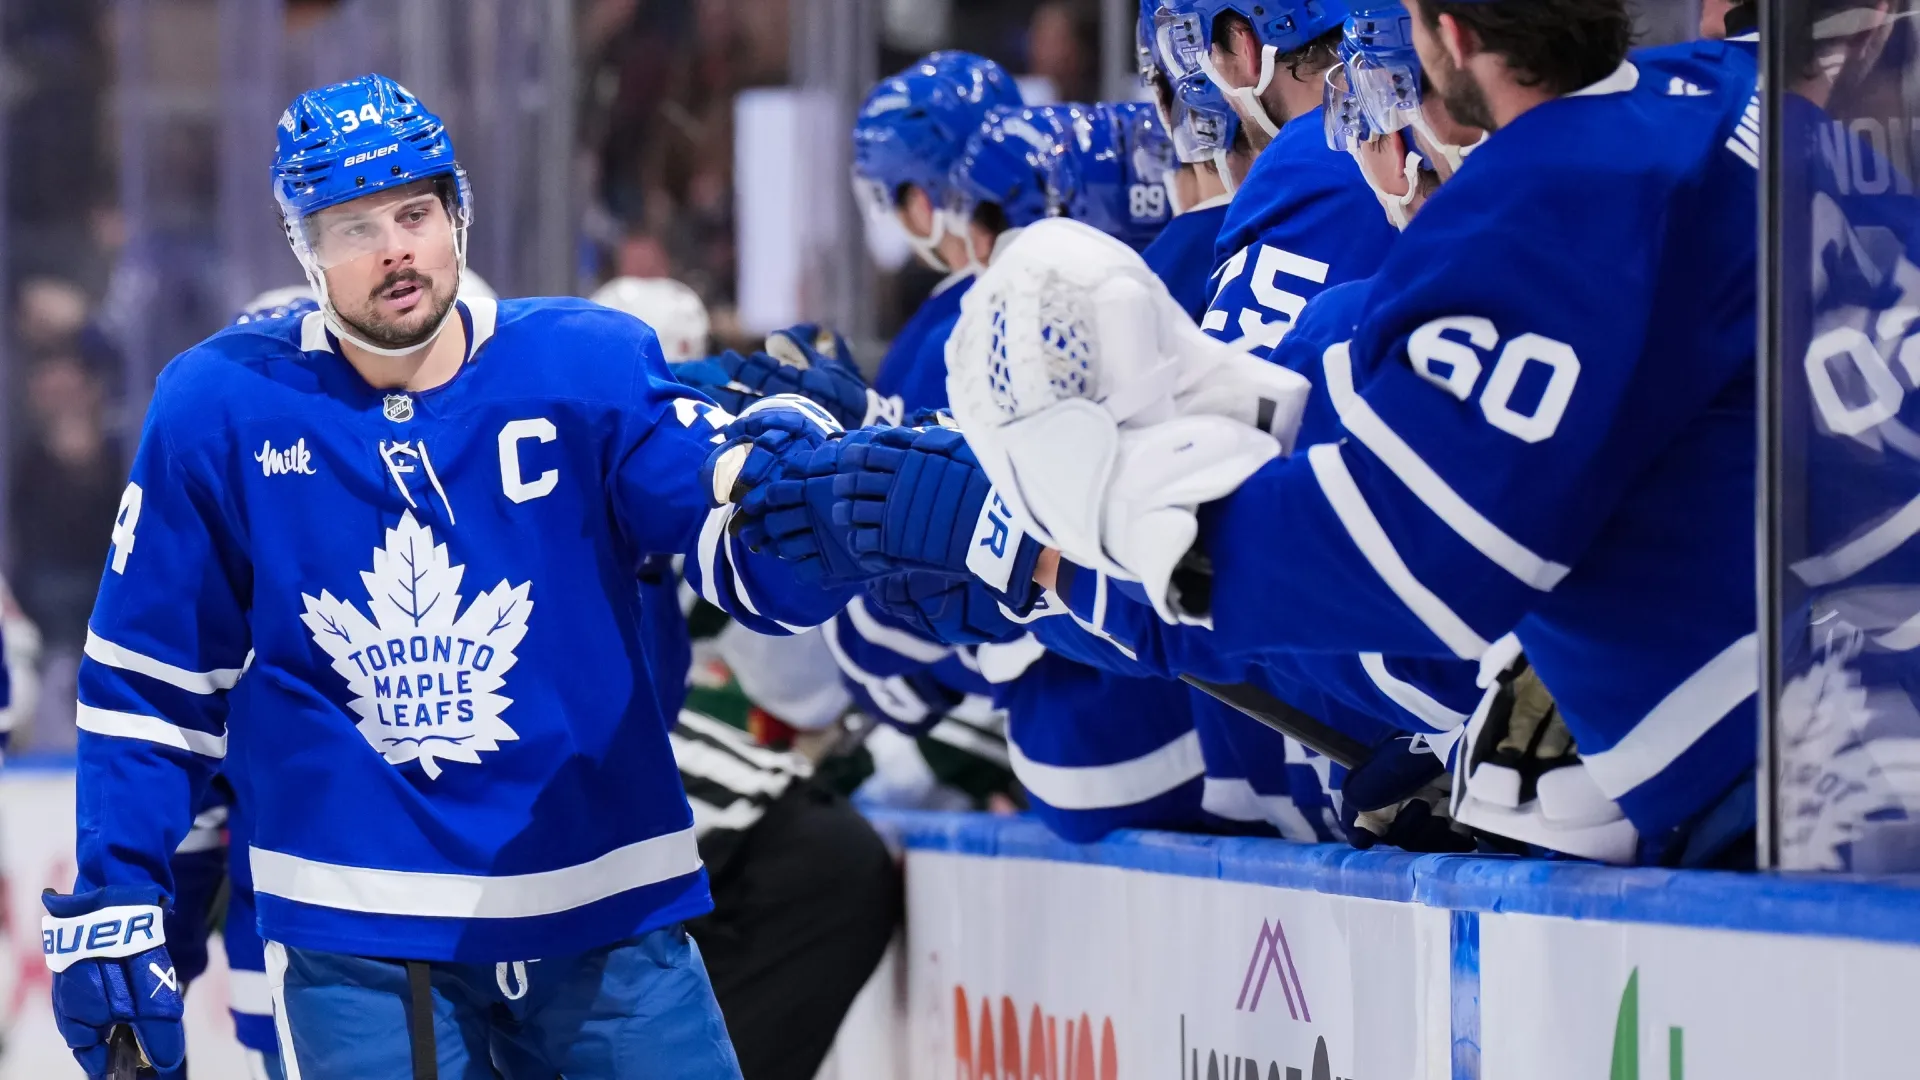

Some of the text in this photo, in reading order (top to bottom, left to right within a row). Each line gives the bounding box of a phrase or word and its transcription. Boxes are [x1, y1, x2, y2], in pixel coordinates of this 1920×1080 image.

[336, 103, 383, 133] 34
[343, 143, 399, 167] BAUER
[1129, 183, 1165, 218] 89
[1407, 315, 1582, 444] 60
[254, 438, 317, 477] Milk
[497, 417, 559, 505] C
[347, 635, 495, 677] TORONTO
[373, 670, 473, 699] MAPLE
[376, 699, 474, 727] LEAFS
[42, 912, 154, 955] AUER
